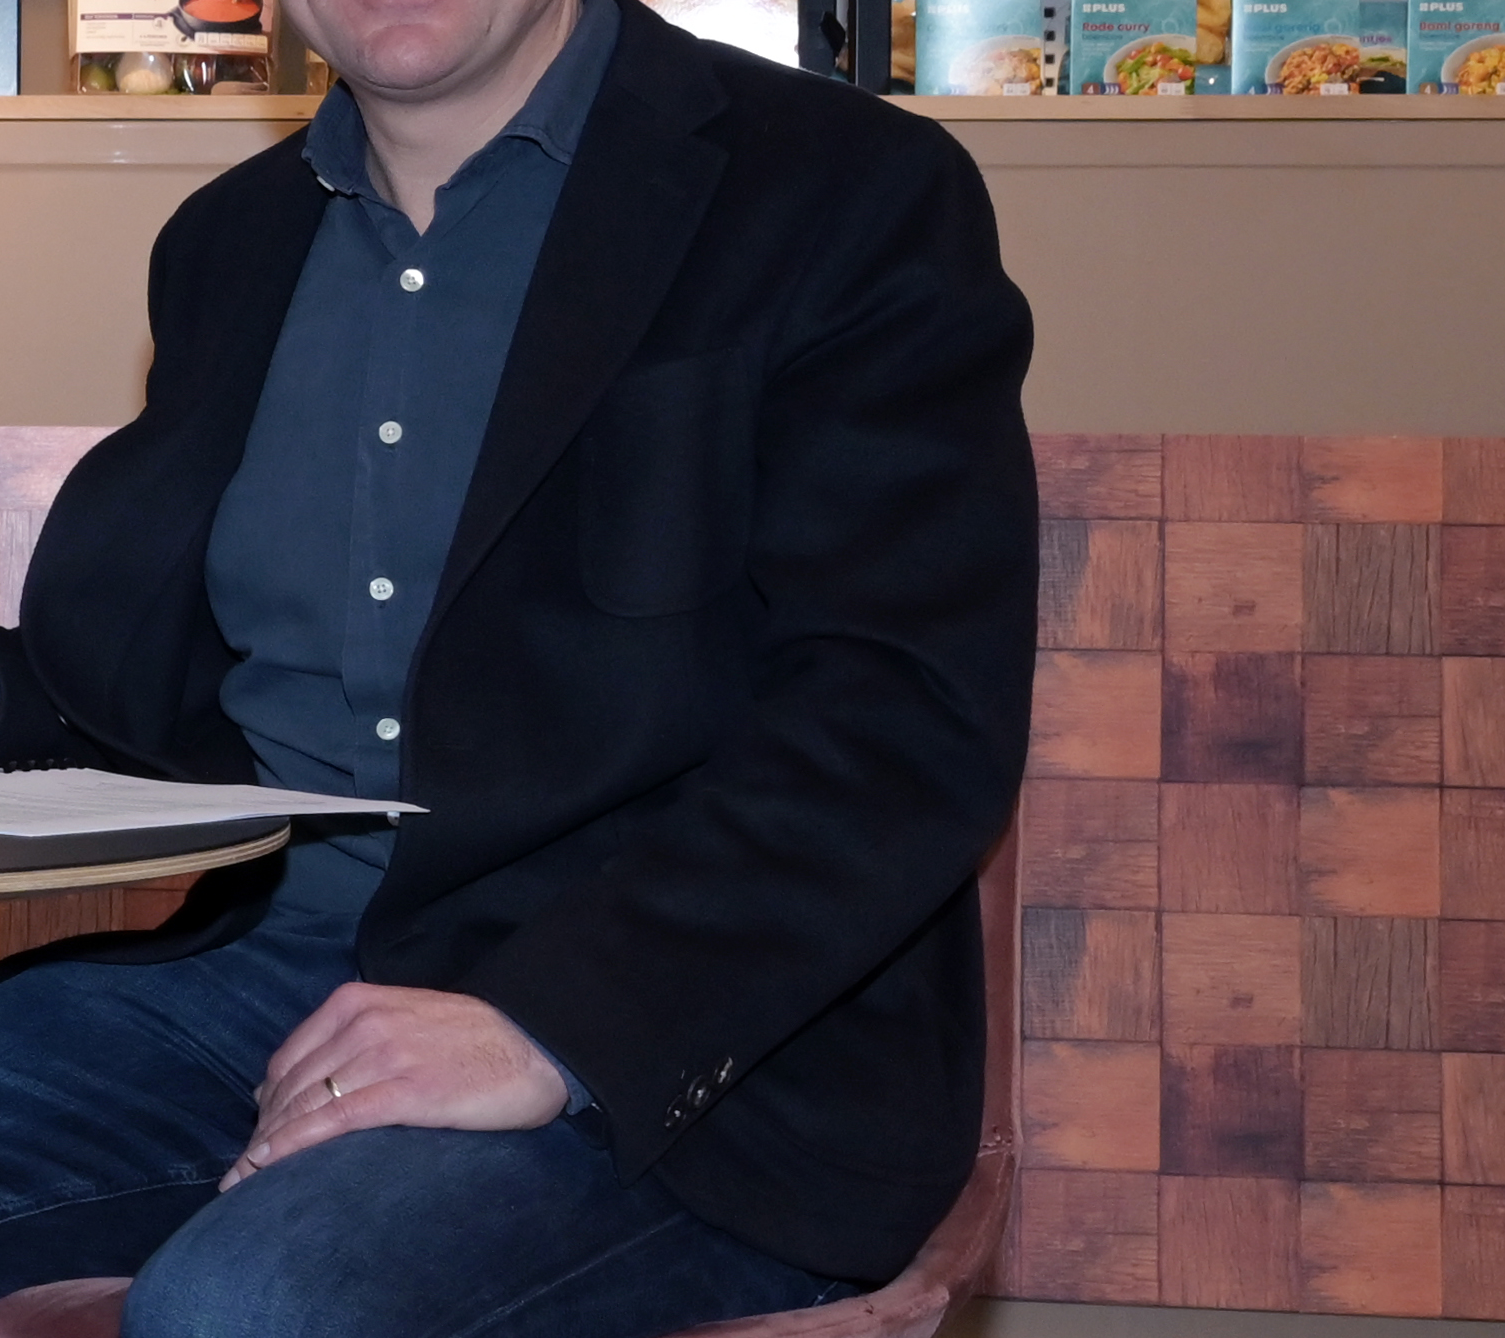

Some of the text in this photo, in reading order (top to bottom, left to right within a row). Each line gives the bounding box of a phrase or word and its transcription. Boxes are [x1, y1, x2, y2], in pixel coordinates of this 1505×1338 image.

[1093, 4, 1125, 12] PLUS
[1254, 4, 1287, 13] PLUS
[1430, 2, 1463, 11] PLUS
[1083, 22, 1150, 33] Rode curry
